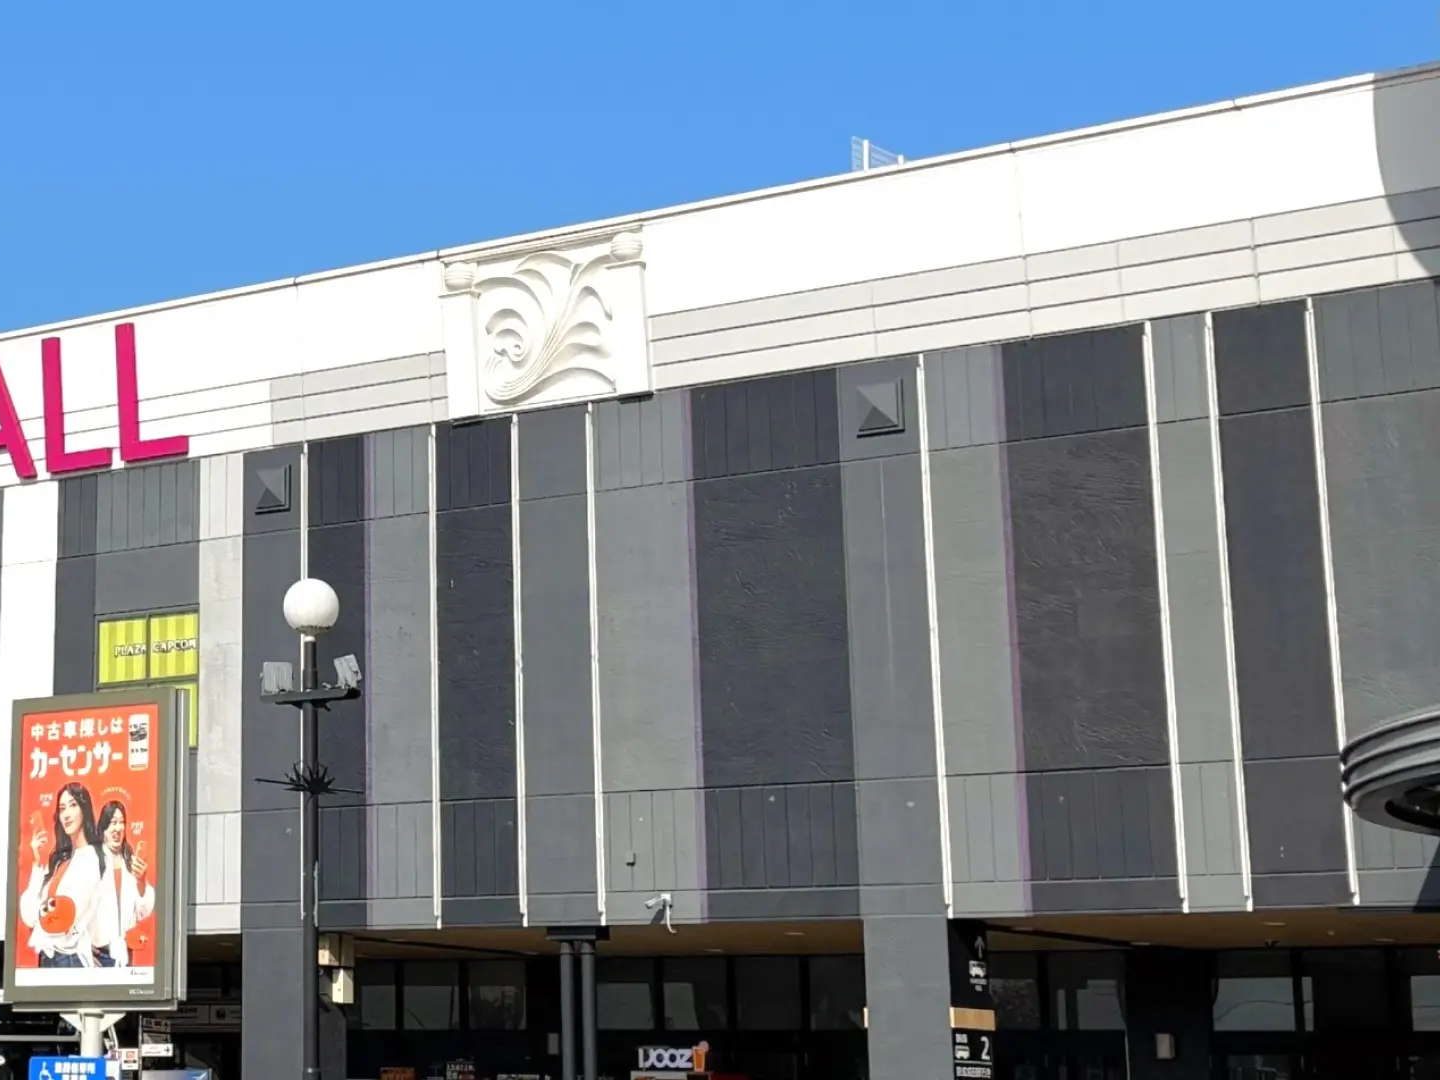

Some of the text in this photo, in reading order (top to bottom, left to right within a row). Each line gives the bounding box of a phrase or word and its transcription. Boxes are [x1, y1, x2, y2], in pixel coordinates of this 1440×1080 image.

[114, 638, 197, 658] PLAZA CAPCOM
[30, 740, 124, 778] カーセンサー
[980, 1036, 991, 1060] 2
